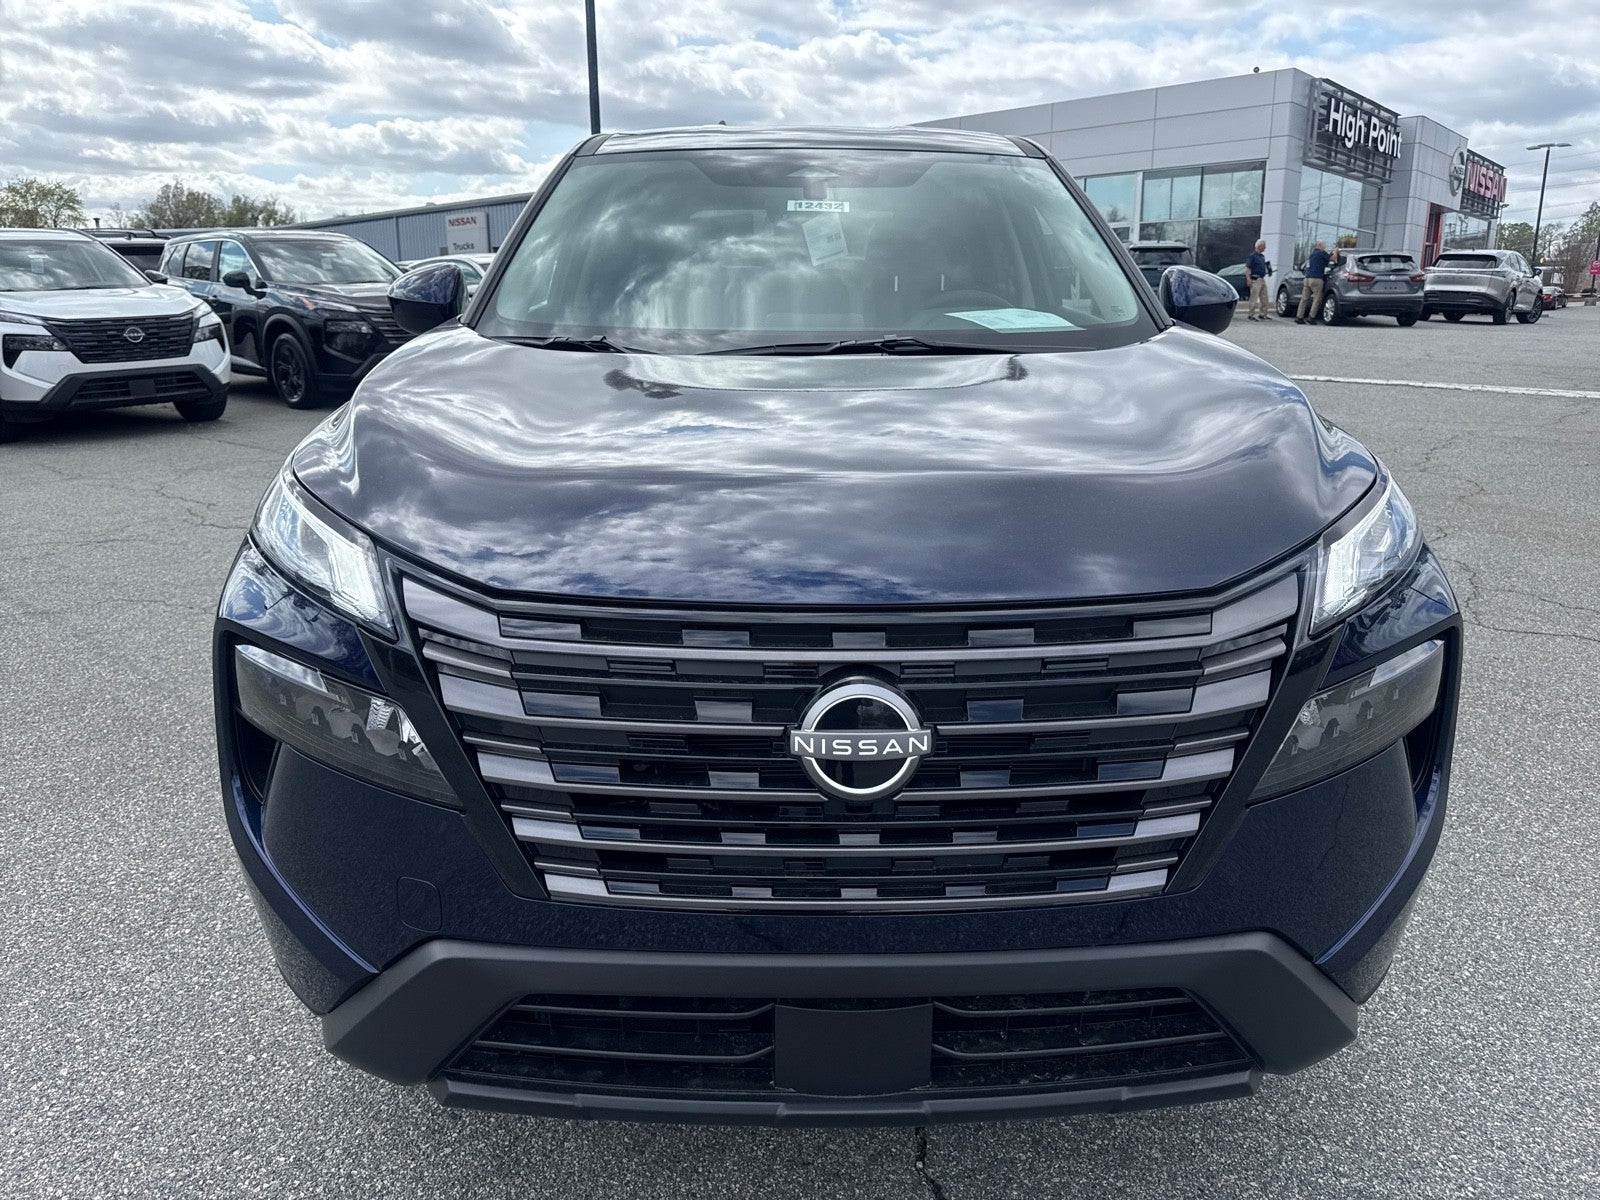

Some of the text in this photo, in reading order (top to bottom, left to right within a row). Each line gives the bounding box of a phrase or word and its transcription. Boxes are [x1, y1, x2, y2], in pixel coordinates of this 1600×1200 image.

[1329, 98, 1402, 159] High Point
[1465, 160, 1507, 203] NISSAN
[448, 216, 477, 227] NISSAN
[453, 242, 475, 250] Trucks
[794, 735, 928, 756] NISSAN
